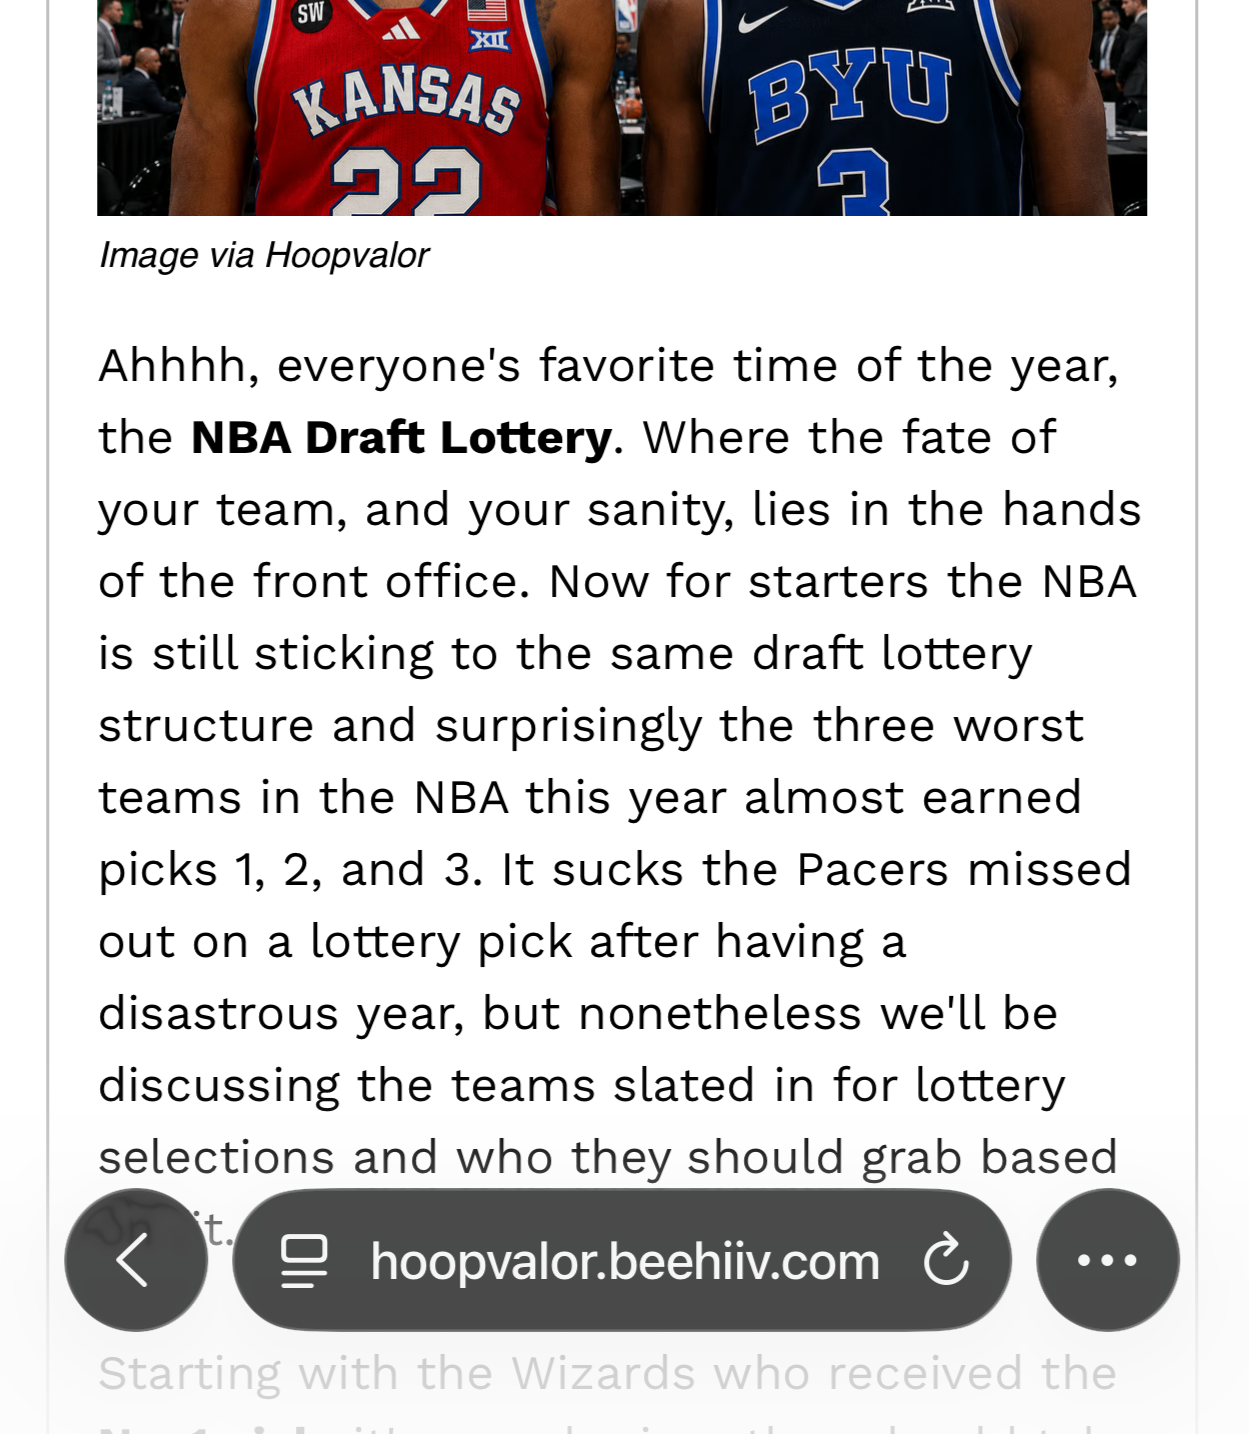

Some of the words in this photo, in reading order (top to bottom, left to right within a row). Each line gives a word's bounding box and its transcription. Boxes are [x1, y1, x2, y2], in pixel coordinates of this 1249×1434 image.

[297, 0, 326, 25] SW
[290, 62, 522, 139] KANSAS
[748, 47, 953, 146] BYU
[330, 146, 483, 216] 22
[817, 147, 890, 216] 3
[100, 241, 198, 275] Image
[211, 241, 254, 268] via
[266, 241, 431, 275] Hoopvalor
[98, 346, 258, 388] Ahhhh,
[279, 348, 519, 392] everyone's
[539, 345, 714, 382] favorite
[733, 347, 837, 382] time
[858, 345, 902, 382] of
[917, 346, 992, 382] the
[1010, 356, 1117, 392] year,
[98, 418, 172, 454] the
[193, 421, 292, 453] NBA
[307, 418, 425, 454] Draft
[442, 421, 622, 464] Lottery.
[643, 418, 789, 454] Where
[808, 418, 883, 454] the
[902, 417, 991, 454] fate
[1012, 417, 1057, 454] of
[99, 710, 313, 742] structure
[334, 706, 413, 742] and
[436, 706, 703, 752] surprisingly
[719, 706, 793, 742] the
[813, 706, 934, 742] three
[953, 710, 1084, 742] worst
[99, 1138, 333, 1174] selections
[355, 1138, 435, 1174] and
[456, 1138, 551, 1174] who
[571, 1138, 672, 1183] they
[688, 1138, 841, 1174] should
[863, 1138, 961, 1184] grab
[983, 1138, 1115, 1174] based
[193, 1210, 233, 1246] t.
[373, 1240, 878, 1288] hoopvalor.beehiiv.com
[99, 1355, 281, 1399] Starting
[299, 1354, 396, 1389] with
[418, 1354, 491, 1389] the
[512, 1354, 694, 1389] Wizards
[714, 1354, 808, 1389] who
[832, 1354, 1020, 1389] received
[1042, 1354, 1115, 1389] the
